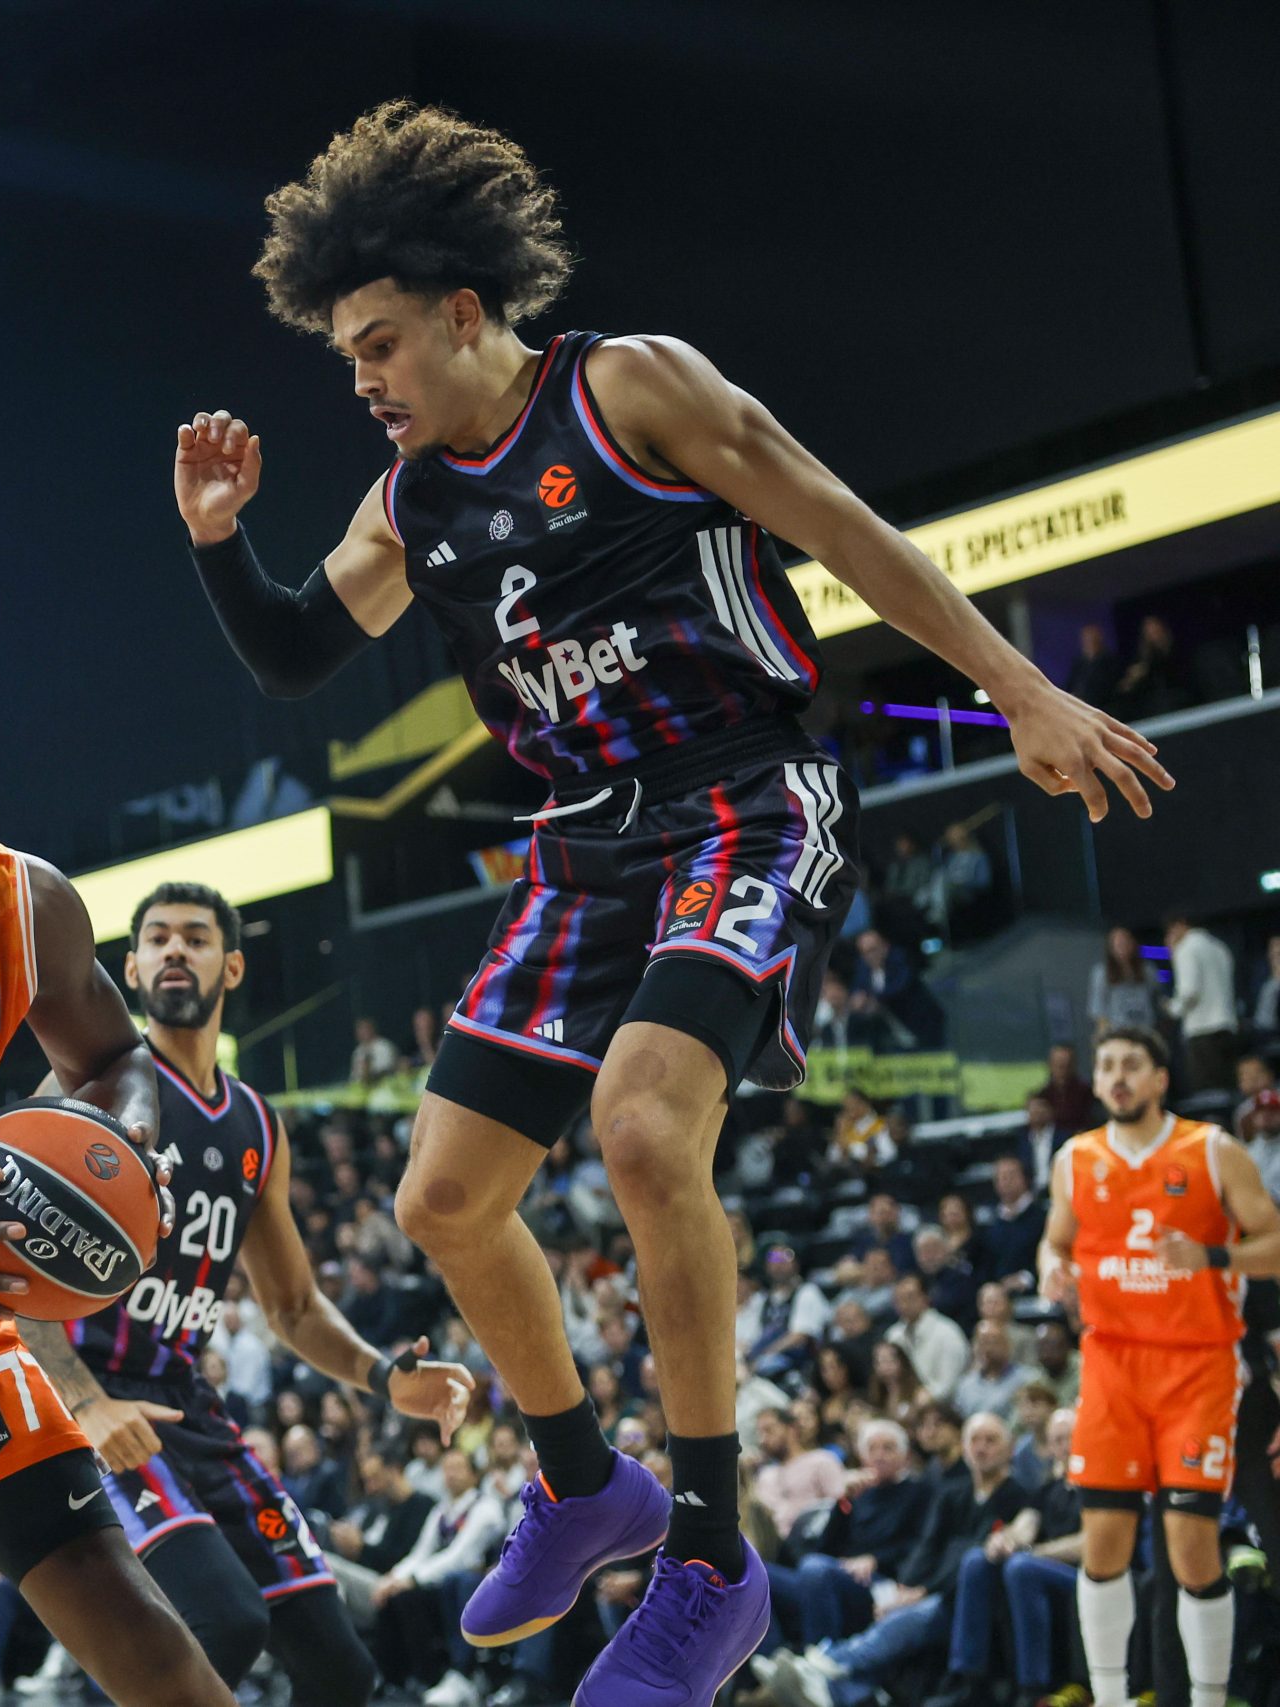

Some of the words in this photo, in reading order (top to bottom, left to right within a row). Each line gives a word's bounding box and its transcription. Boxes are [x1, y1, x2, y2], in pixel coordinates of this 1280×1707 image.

[966, 488, 1128, 569] SPECTATEUR
[494, 564, 540, 644] 2
[497, 621, 649, 724] OlyBet
[714, 875, 777, 955] 2
[179, 1190, 237, 1262] 20
[1126, 1208, 1154, 1251] 2
[126, 1276, 224, 1339] OlyBe
[1202, 1434, 1227, 1480] 2
